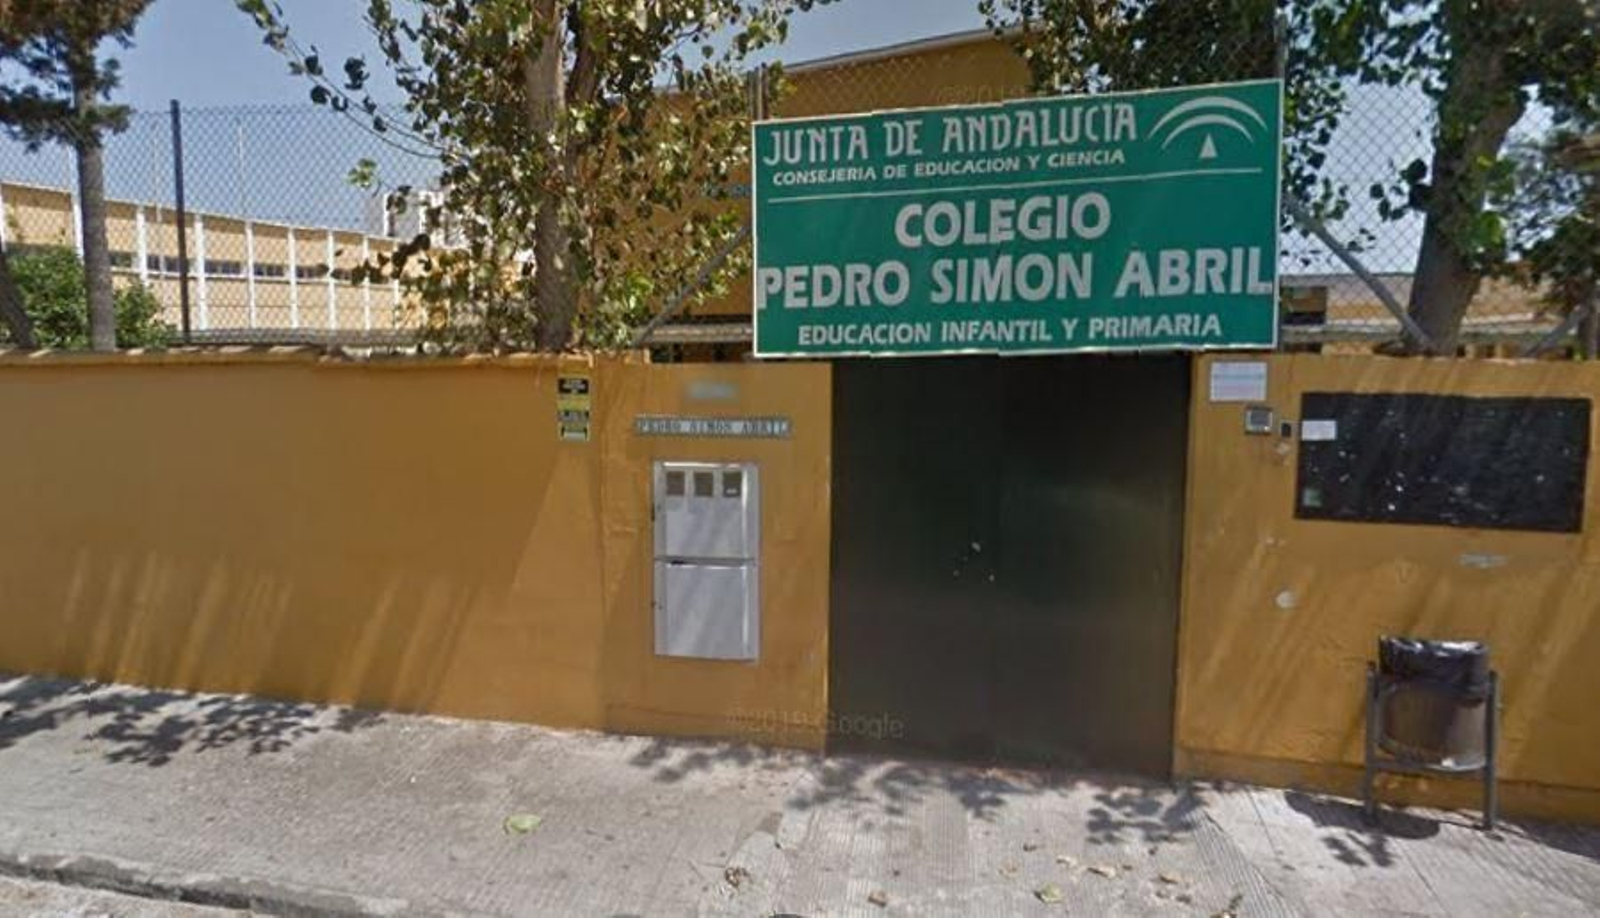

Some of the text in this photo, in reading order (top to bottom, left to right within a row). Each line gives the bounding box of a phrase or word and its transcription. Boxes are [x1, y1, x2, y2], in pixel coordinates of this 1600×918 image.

[763, 103, 1137, 165] JUNTA DE ANDALUCIA
[773, 150, 1125, 185] CONSEJERIA DE EDUCACION Y CIENCIA
[895, 192, 1111, 247] COLEGIO
[758, 247, 1273, 309] PEDRO SIMON ABRIL
[798, 314, 1222, 346] EDUCACION INFANTIL Y PRIMARIA
